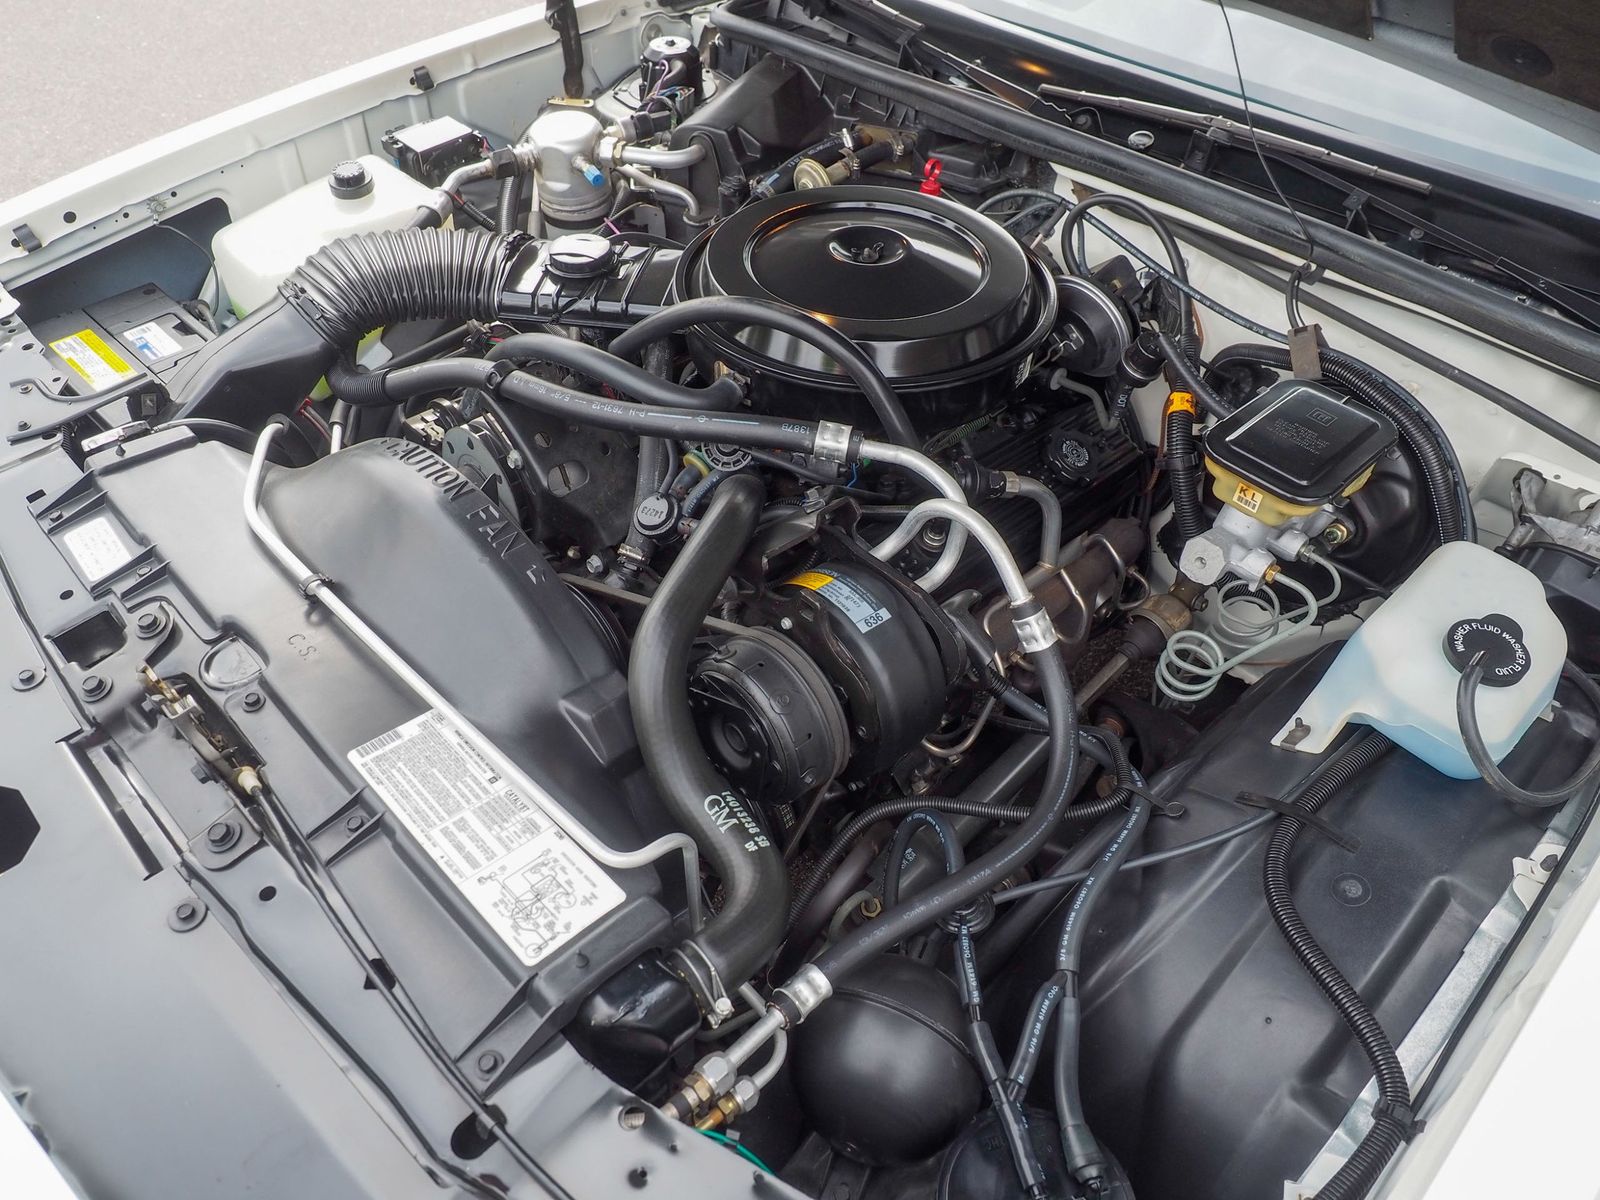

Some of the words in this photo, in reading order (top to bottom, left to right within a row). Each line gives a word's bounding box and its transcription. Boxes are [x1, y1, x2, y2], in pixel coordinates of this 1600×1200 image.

[465, 503, 527, 560] FAN
[864, 612, 884, 628] 636
[1471, 622, 1501, 635] FLUID
[1453, 623, 1473, 653] WASHER
[1502, 631, 1526, 665] WASHER
[1495, 662, 1522, 676] FLUID
[504, 789, 530, 813] CATALYST
[703, 794, 740, 834] GM
[721, 790, 760, 834] 14013238
[744, 840, 759, 852] DF
[1061, 934, 1069, 946] GM
[972, 990, 981, 1003] GM
[1033, 1022, 1042, 1036] GM
